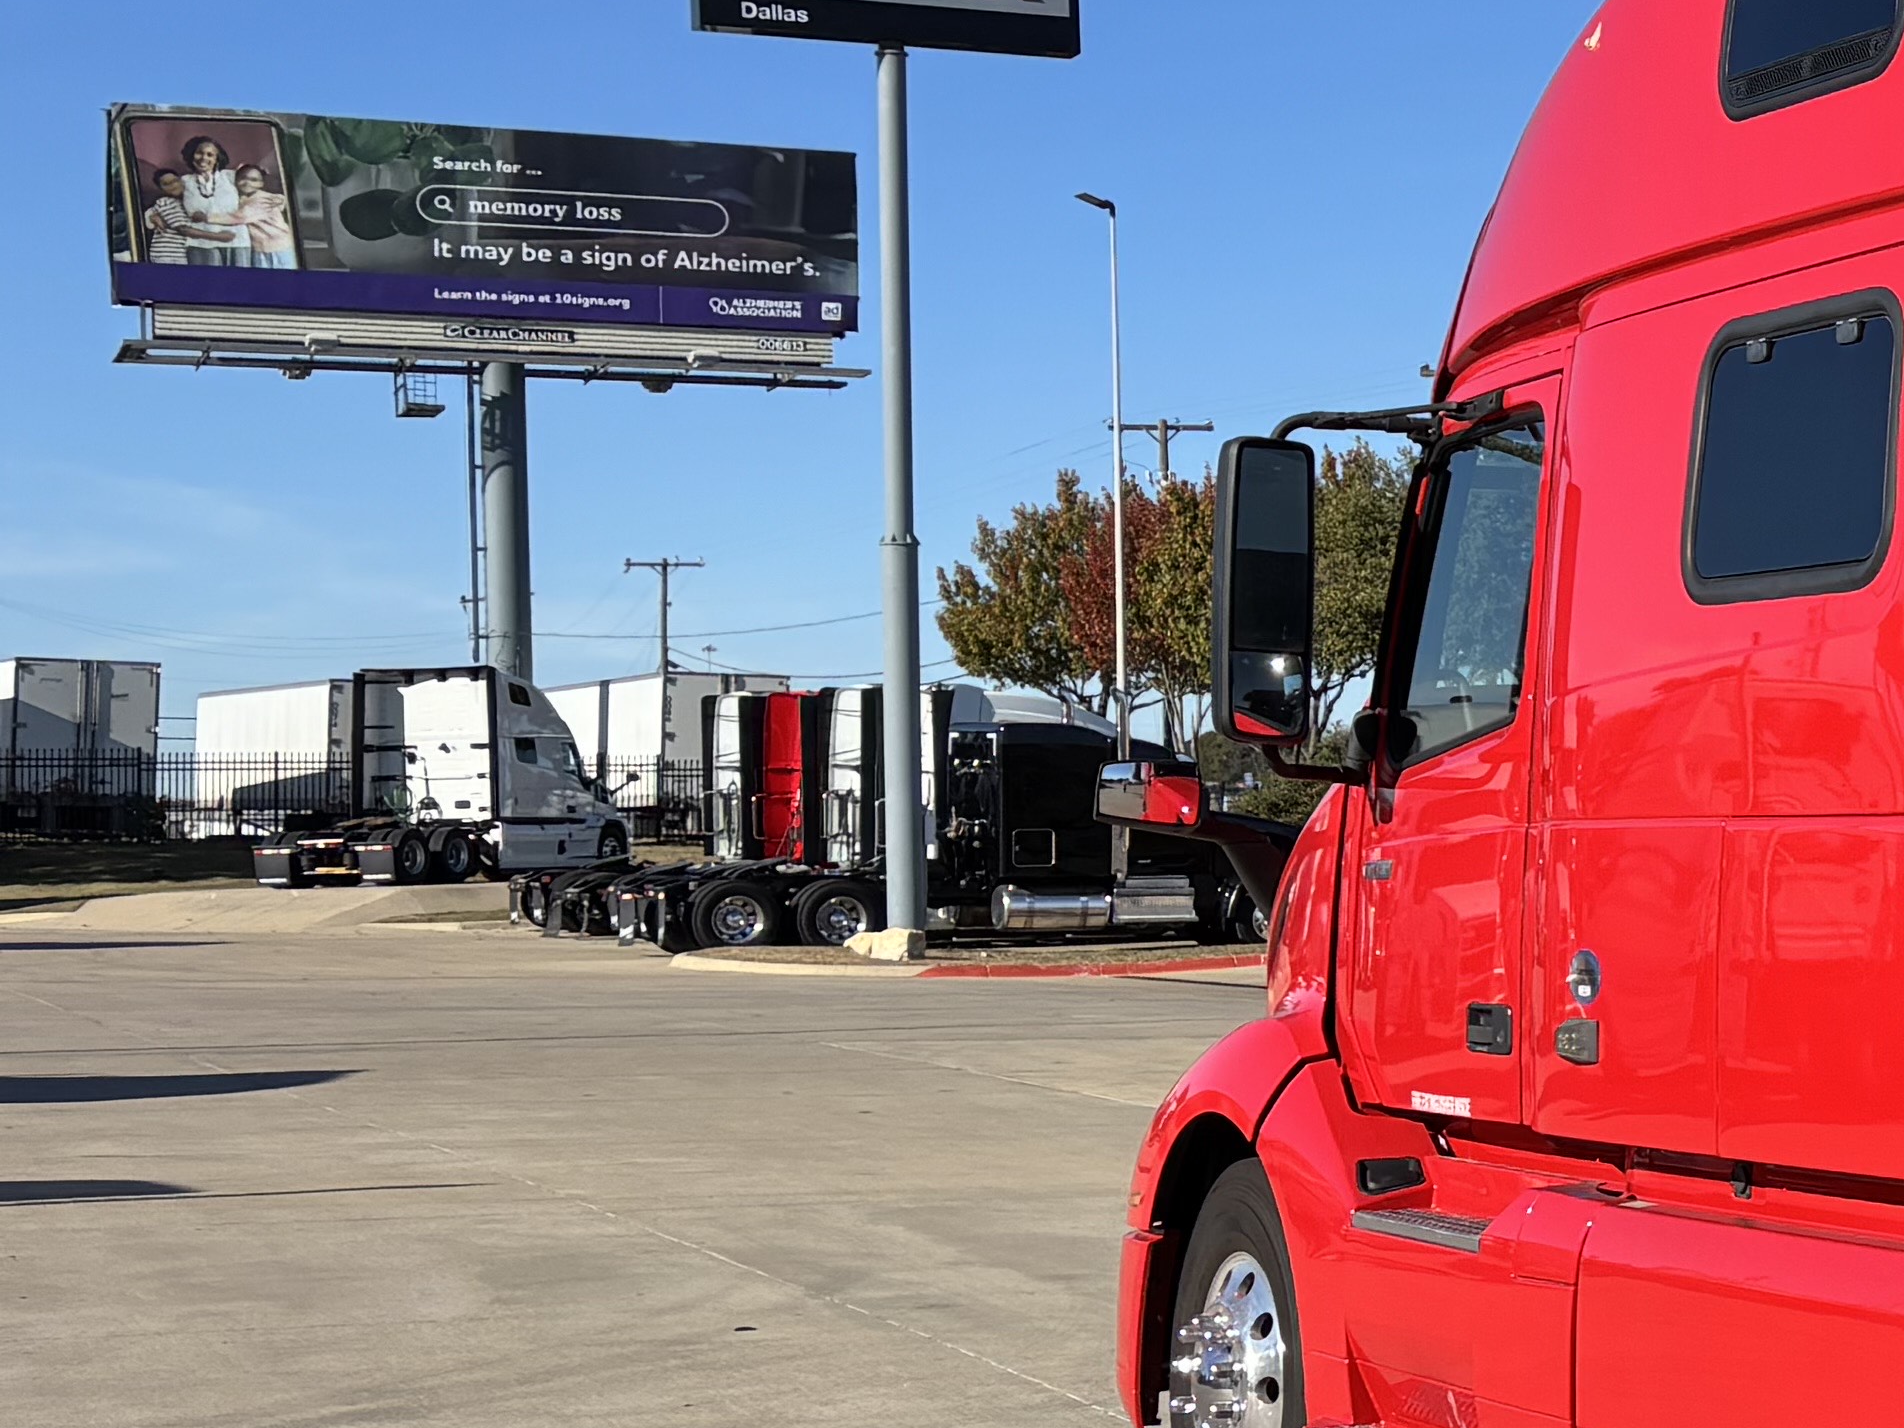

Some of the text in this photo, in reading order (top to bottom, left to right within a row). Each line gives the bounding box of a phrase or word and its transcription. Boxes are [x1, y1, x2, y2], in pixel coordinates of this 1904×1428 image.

[740, 0, 809, 23] Dallas
[432, 156, 492, 172] Search
[495, 160, 523, 174] for
[468, 199, 622, 222] memory loss
[433, 237, 821, 277] It may be a sign of Alzheimer's.
[434, 287, 472, 301] Learn
[475, 289, 498, 302] the
[501, 290, 535, 305] signs
[537, 293, 551, 304] at
